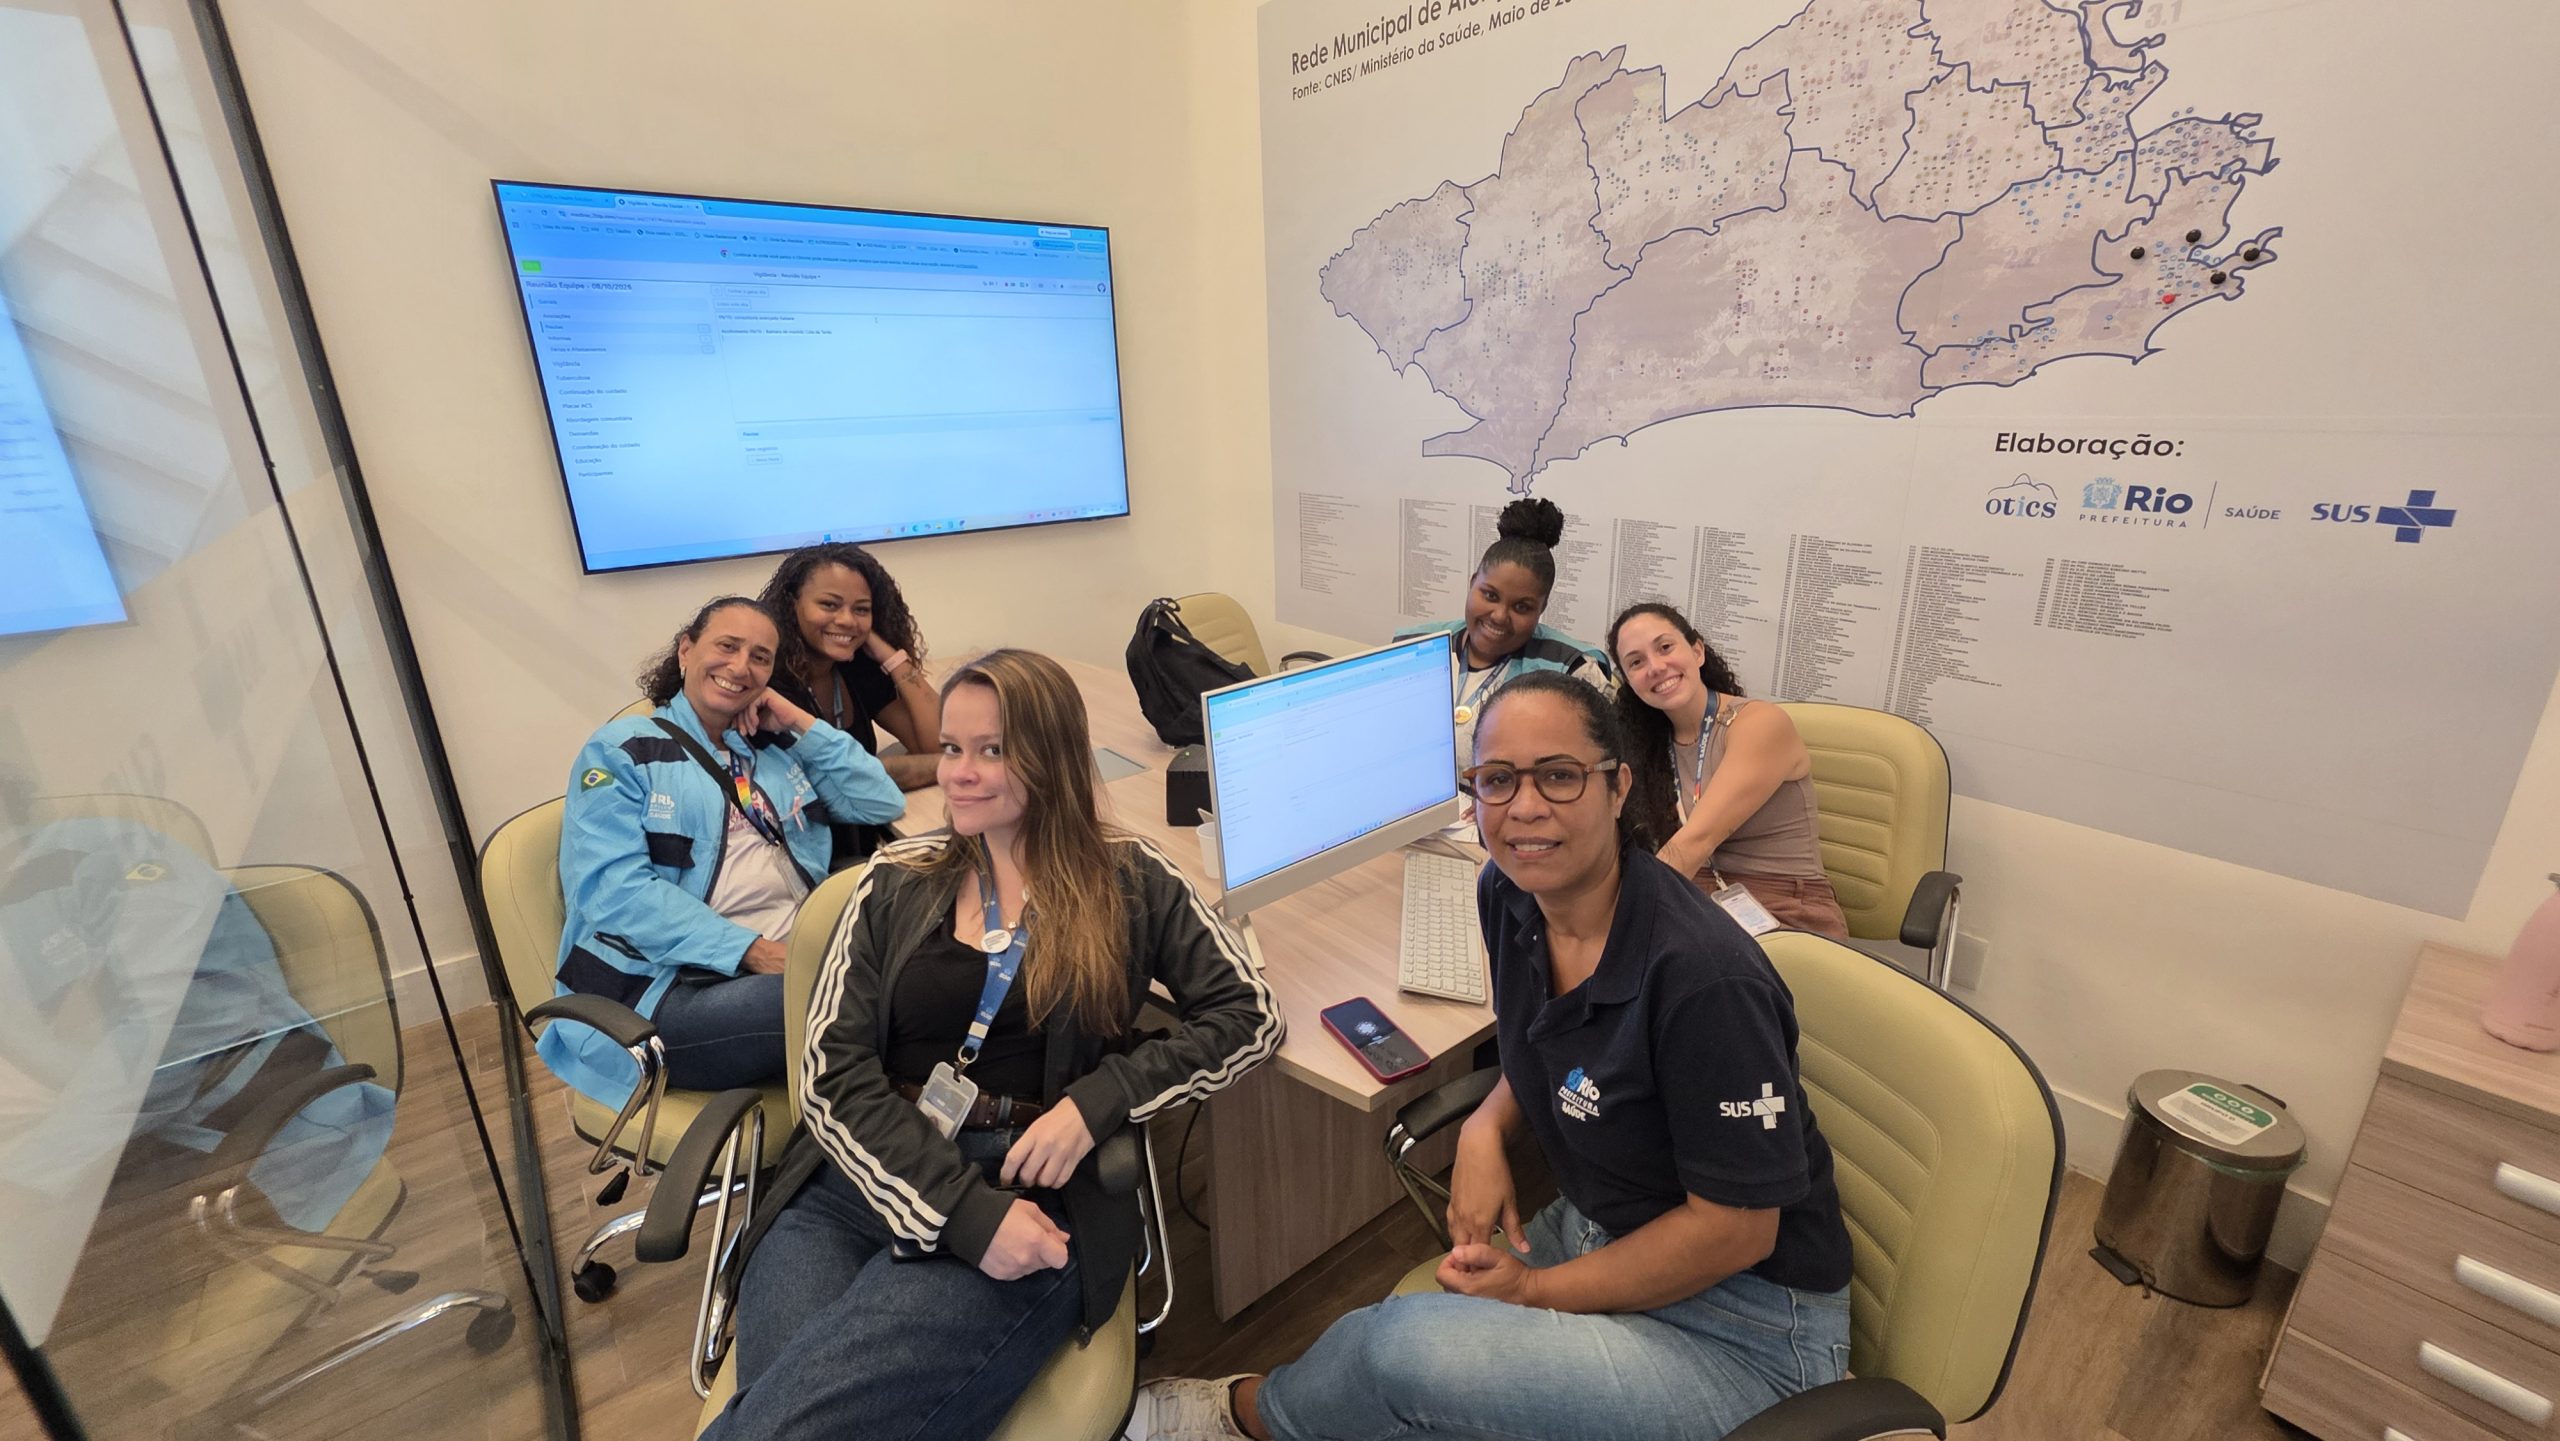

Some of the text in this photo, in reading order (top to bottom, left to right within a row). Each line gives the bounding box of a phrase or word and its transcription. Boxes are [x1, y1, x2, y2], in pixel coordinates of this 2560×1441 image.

[1291, 47, 1329, 75] Rede
[1333, 10, 1413, 60] Municipal
[1417, 0, 1441, 27] de
[1292, 80, 1322, 100] Fonte:
[1324, 64, 1357, 89] CNES/
[1360, 46, 1414, 77] Ministério
[1418, 38, 1435, 55] da
[1439, 22, 1485, 48] Saúde,
[1488, 6, 1525, 31] Maio
[1530, 0, 1550, 15] de
[1994, 432, 2185, 460] Elaboração:
[1985, 493, 2058, 519] otics
[2123, 484, 2194, 514] Rio
[2078, 513, 2188, 529] PREFEITURA
[2225, 505, 2281, 521] SAÚDE
[2310, 502, 2371, 524] SUS
[1577, 1076, 1601, 1101] Rio
[1719, 1101, 1751, 1118] SUS
